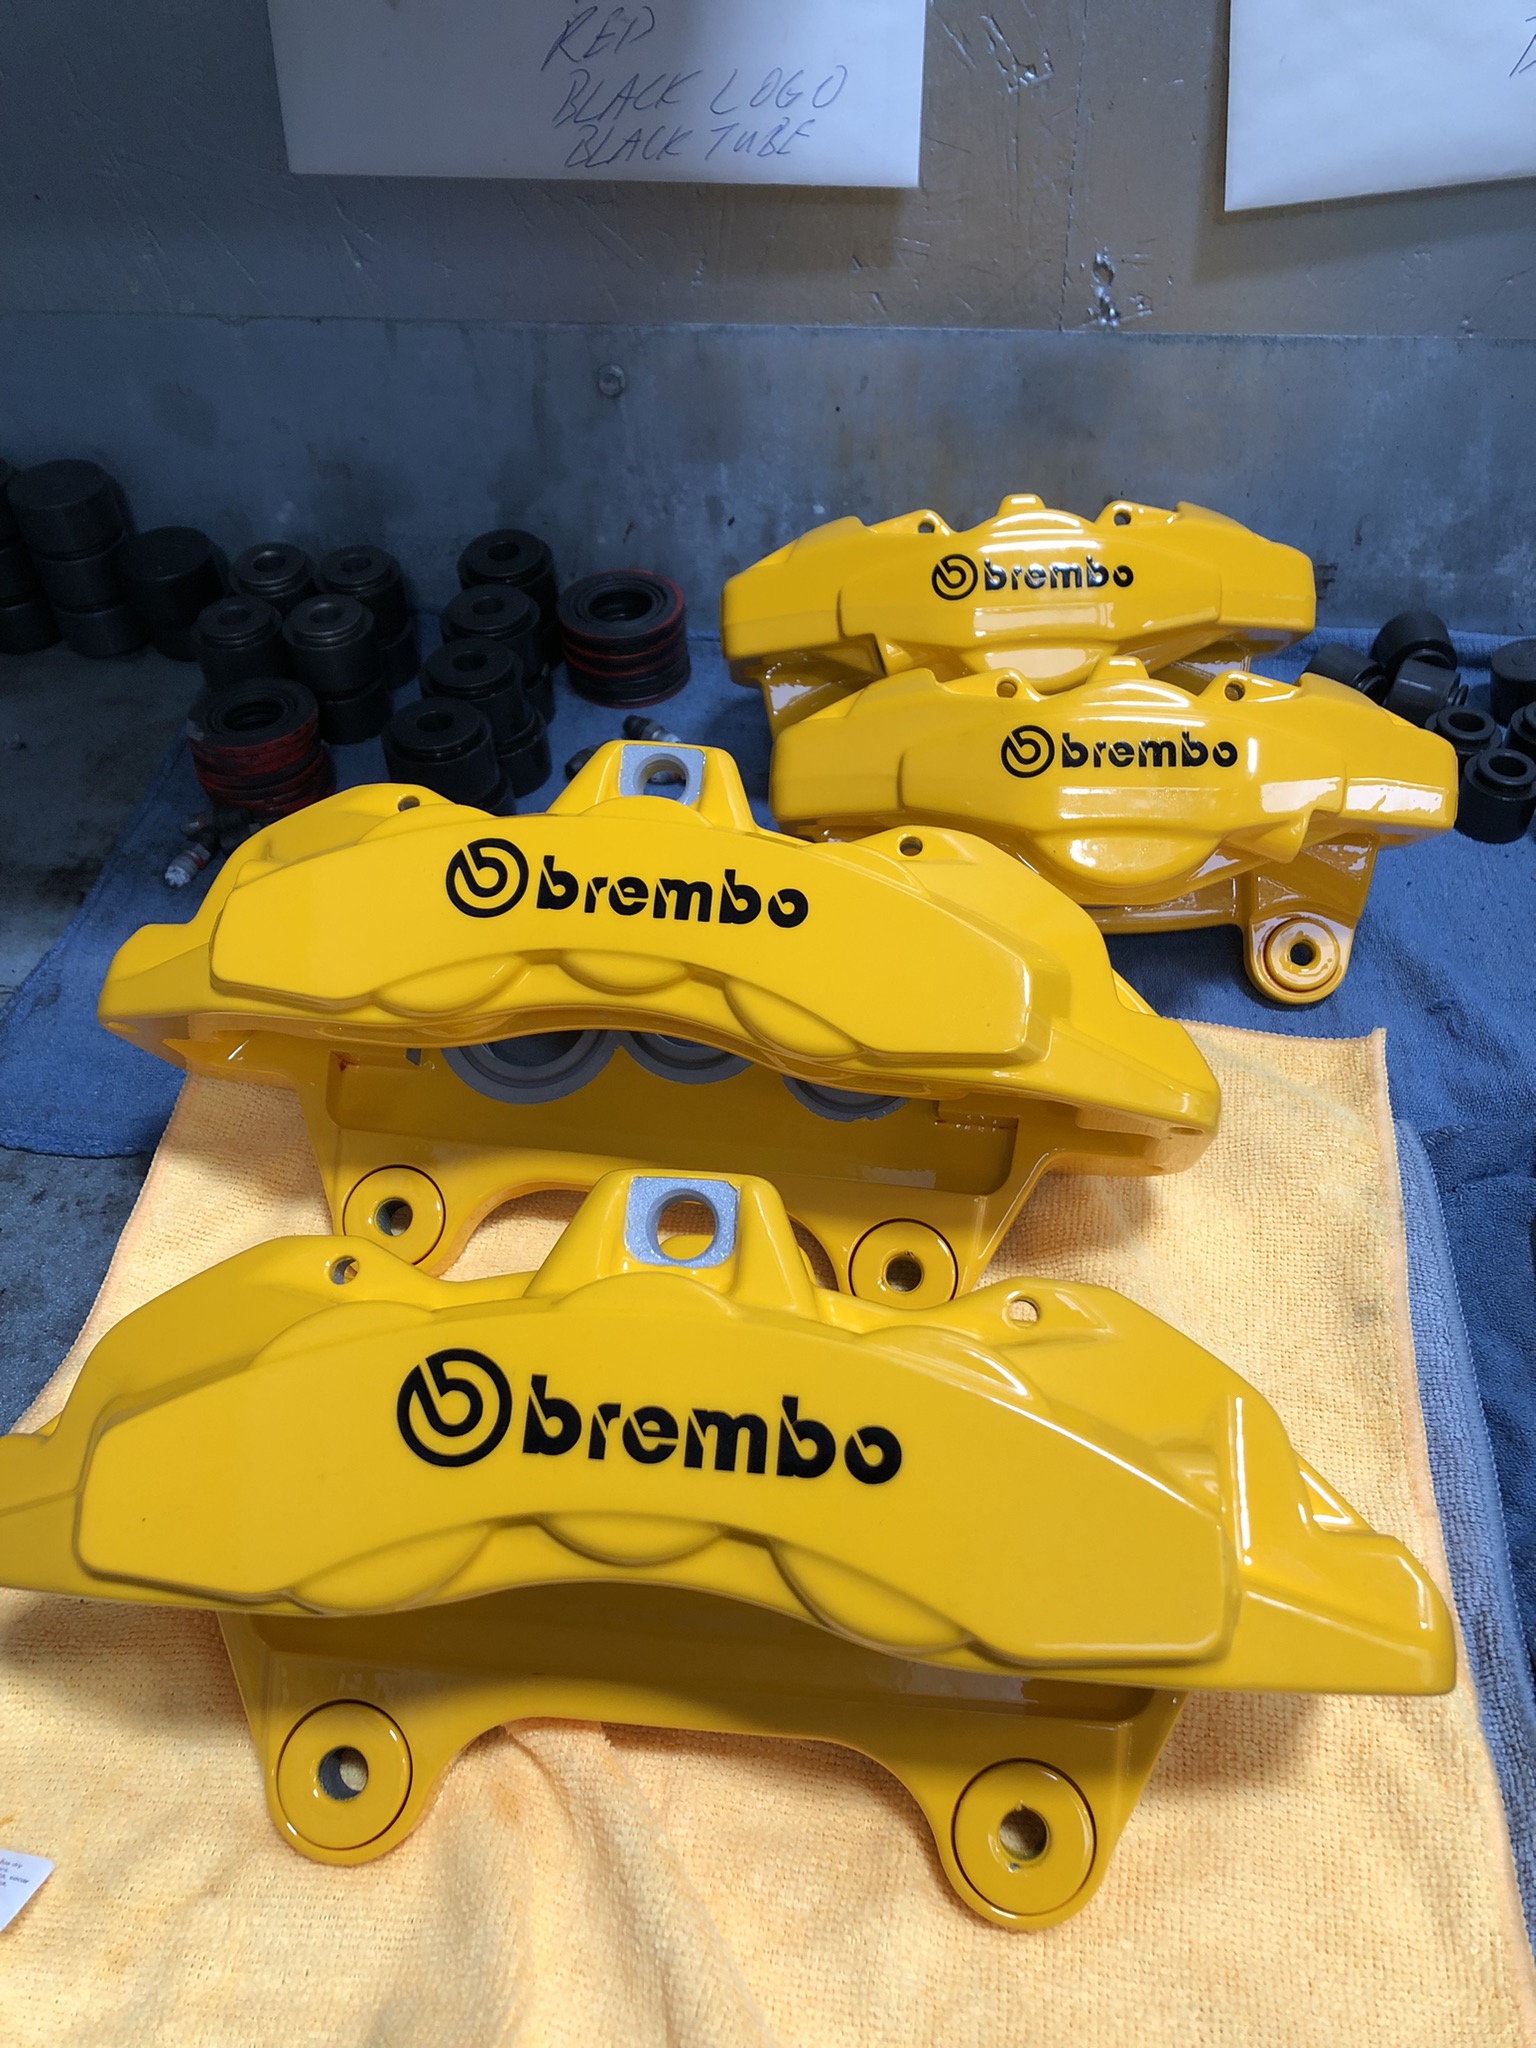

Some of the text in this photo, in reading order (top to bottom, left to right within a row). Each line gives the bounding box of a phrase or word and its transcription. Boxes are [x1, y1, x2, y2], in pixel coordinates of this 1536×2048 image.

[553, 64, 848, 128] BLACK LOGO
[564, 123, 694, 168] BLACK
[983, 555, 1134, 591] brembo
[1061, 731, 1238, 768] brembo
[536, 855, 809, 929] brembo
[522, 1374, 903, 1485] brembo
